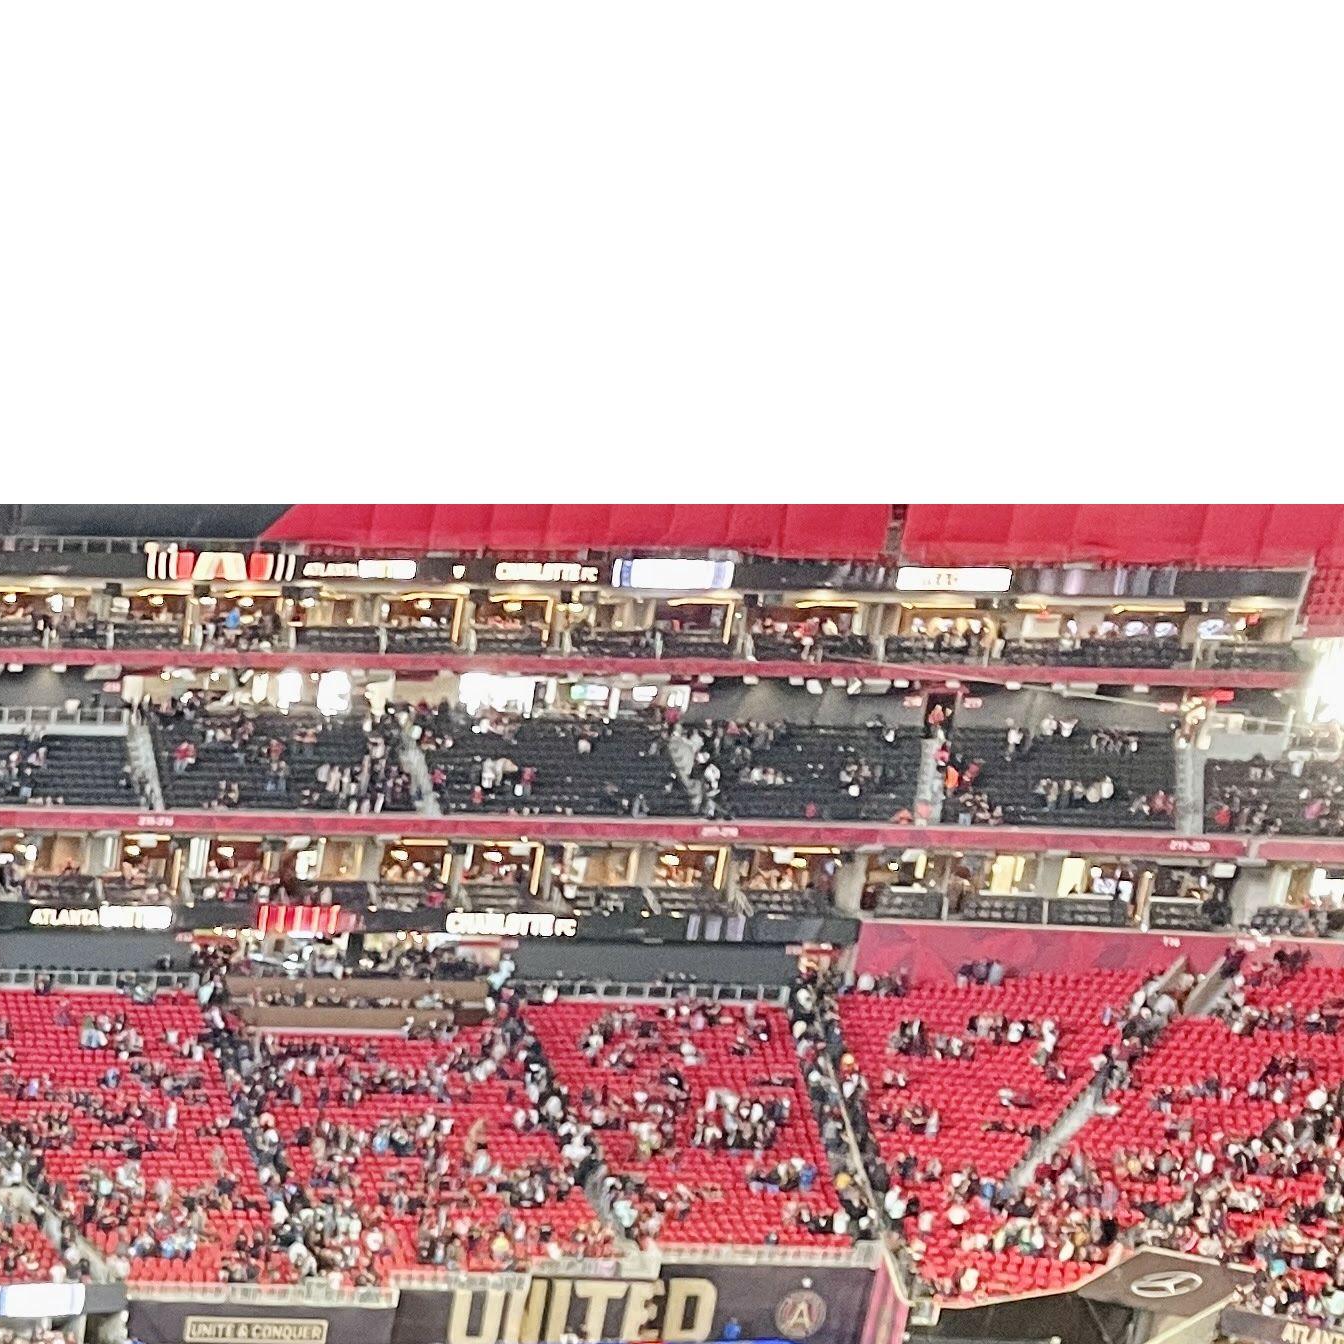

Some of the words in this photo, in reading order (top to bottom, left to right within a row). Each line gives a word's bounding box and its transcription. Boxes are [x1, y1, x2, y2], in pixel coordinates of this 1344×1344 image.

[29, 907, 100, 926] ATLANTA
[446, 910, 555, 936] CHARLOTTE
[555, 917, 578, 936] FC
[189, 1320, 234, 1338] UNITE
[251, 1322, 323, 1341] CONQUER
